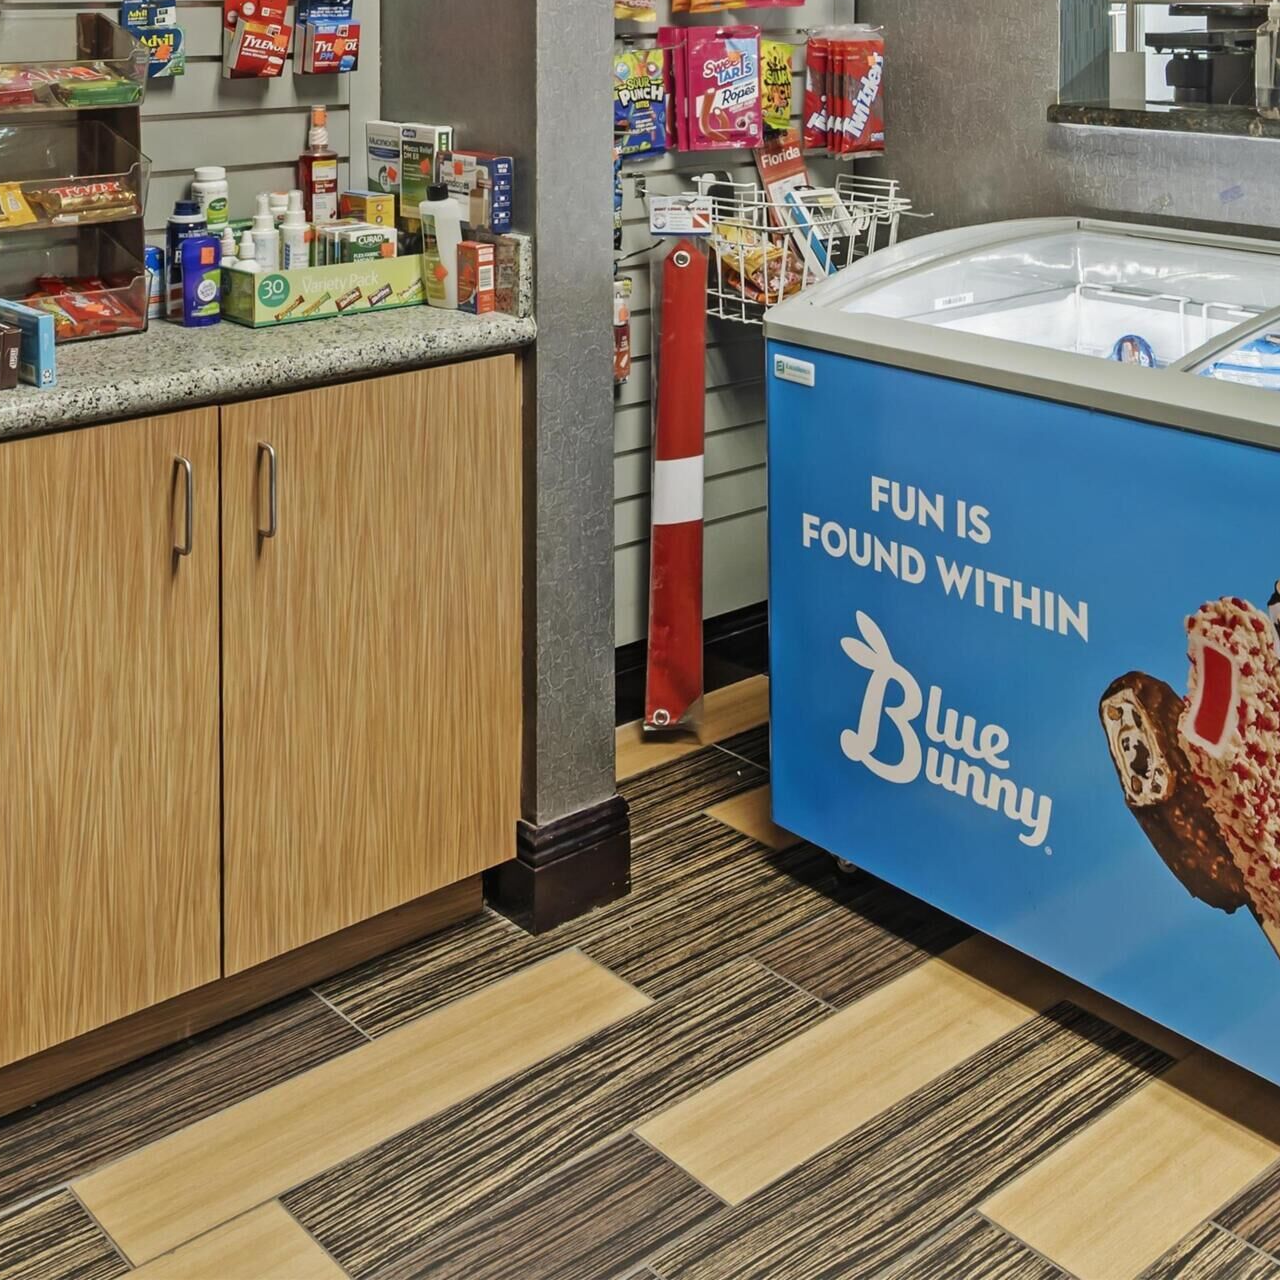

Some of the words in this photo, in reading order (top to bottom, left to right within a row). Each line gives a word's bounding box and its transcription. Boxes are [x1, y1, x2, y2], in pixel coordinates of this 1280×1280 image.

[128, 8, 149, 19] Advil
[140, 33, 174, 48] Advil
[315, 40, 359, 52] TYLOL
[626, 76, 650, 90] SOUR
[618, 86, 664, 107] PUNCH
[722, 85, 756, 106] Ropes
[762, 146, 801, 169] Florida
[358, 234, 383, 243] CURAD
[261, 279, 284, 300] 30
[302, 275, 347, 291] Variety
[350, 270, 379, 284] Pack
[871, 475, 945, 532] FUN
[956, 499, 992, 545] IS
[802, 513, 926, 585] FOUND
[935, 555, 1089, 644] WITHIN
